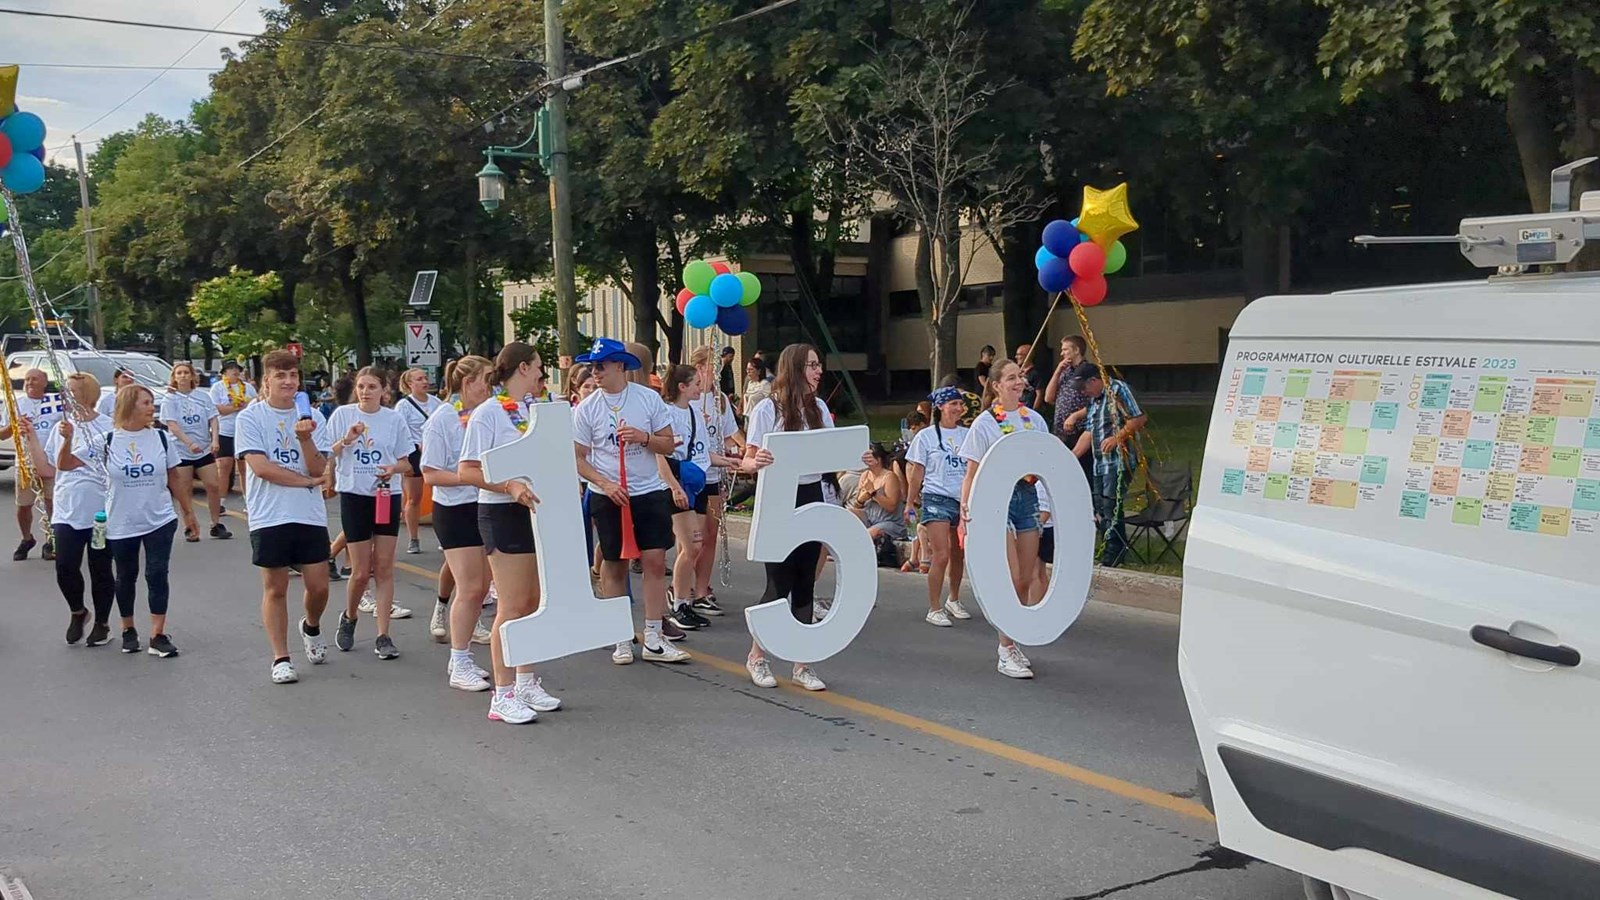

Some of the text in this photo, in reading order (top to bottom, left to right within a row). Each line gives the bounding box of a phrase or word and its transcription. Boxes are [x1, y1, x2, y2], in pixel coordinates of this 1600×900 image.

[1236, 351, 1517, 370] PROGRAMMATION CULTURELLE ESTIVALE 2023
[1224, 367, 1242, 413] JUILLET
[273, 447, 299, 464] 150
[353, 448, 382, 464] 150
[121, 463, 155, 479] 150
